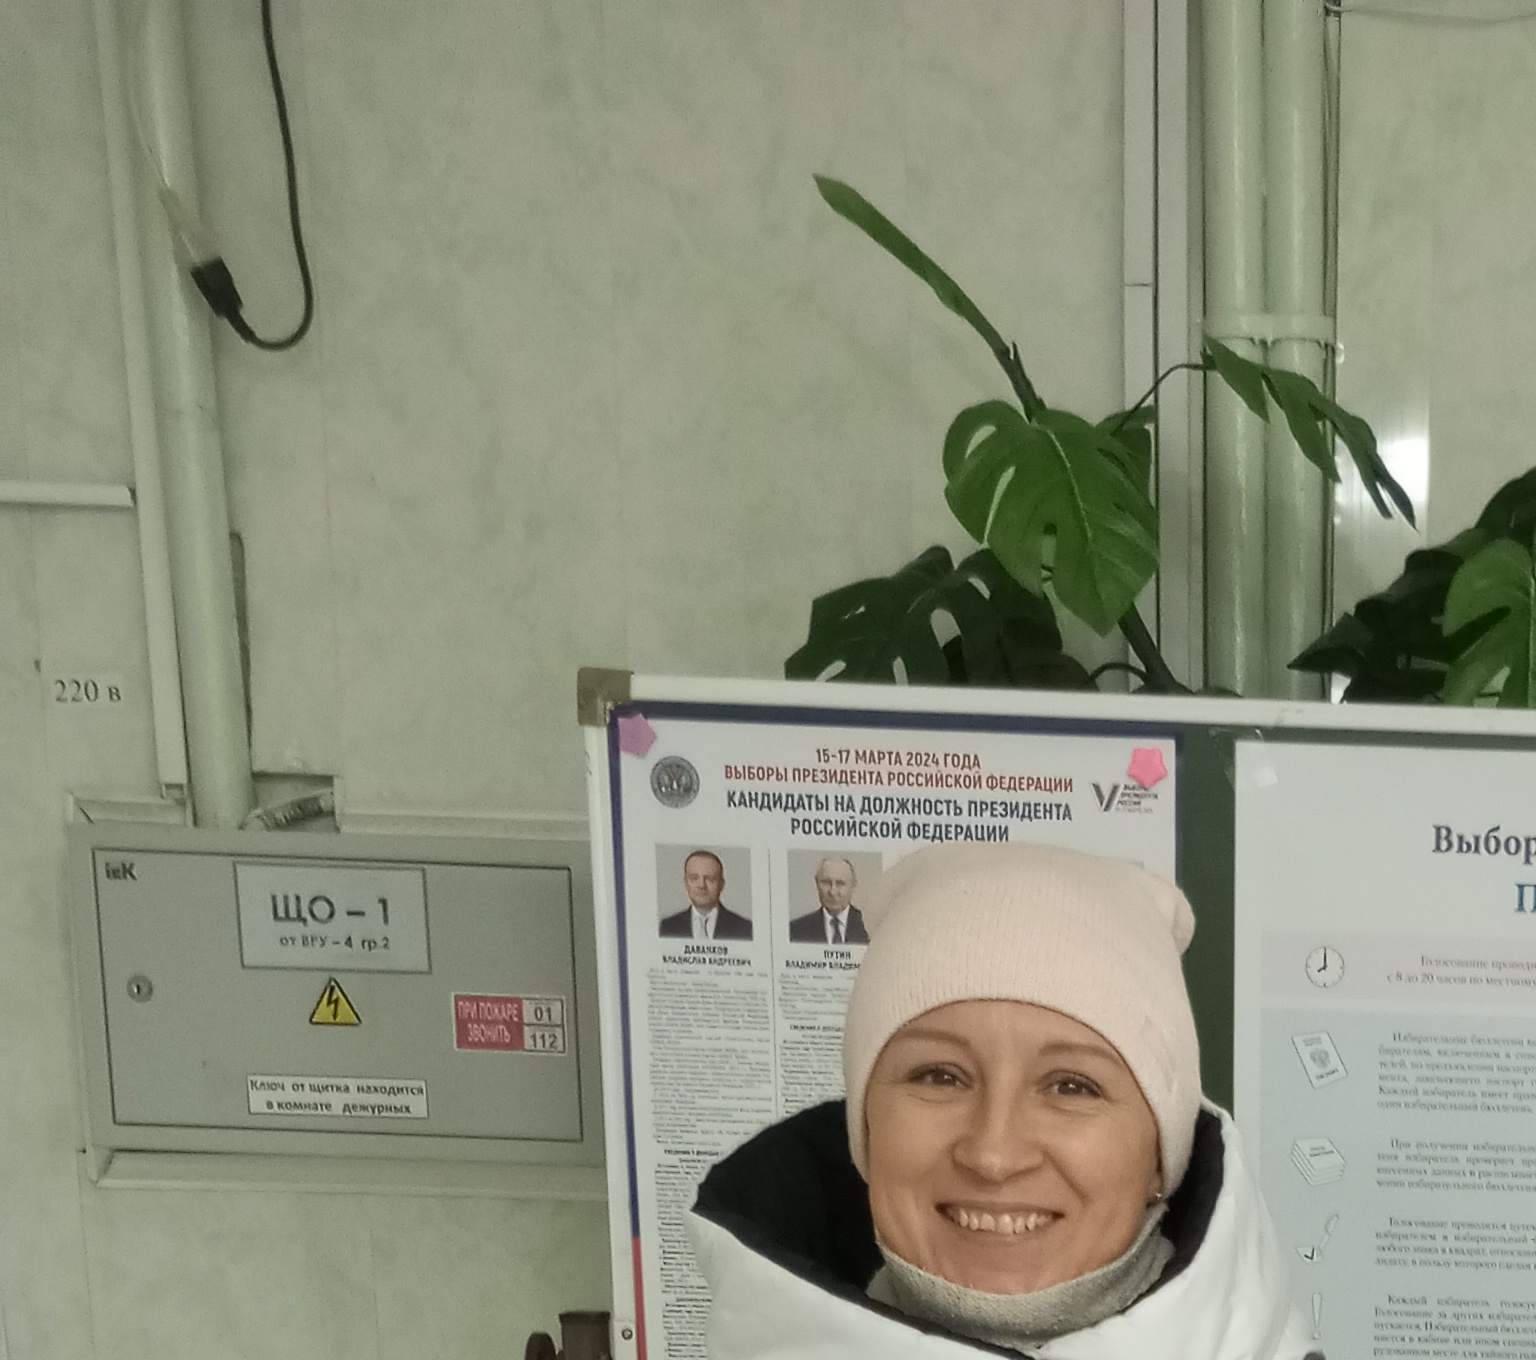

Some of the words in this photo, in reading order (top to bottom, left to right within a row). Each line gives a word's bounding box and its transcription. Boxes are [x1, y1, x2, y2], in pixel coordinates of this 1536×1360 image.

[54, 679, 99, 703] 220
[815, 749, 851, 765] 15-17
[855, 750, 904, 766] МАРТА
[906, 751, 941, 768] 2024
[943, 752, 982, 770] ГОДА
[724, 765, 788, 782] ВЫБОРЫ
[792, 767, 884, 786] ПРЕЗИДЕНТА
[887, 769, 983, 789] РОССИЙСКОЙ
[985, 775, 1073, 793] ФЕДЕРАЦИИ
[727, 791, 829, 812] КАНДИДАТЫ
[834, 794, 856, 813] НА
[859, 796, 963, 820] ДОЛЖНОСТЬ
[967, 800, 1073, 821] ПРЕЗИДЕНТА
[790, 816, 902, 838] РОССИЙСКОЙ
[906, 822, 1009, 843] ФЕДЕРАЦИИ
[270, 894, 336, 926] ЩО
[377, 897, 389, 926] 1
[823, 950, 851, 960] ПУТИН
[534, 1005, 553, 1022] 01
[530, 1032, 558, 1050] 112
[249, 1079, 286, 1095] Ключ
[291, 1082, 305, 1092] от
[308, 1083, 350, 1094] щитка
[356, 1083, 425, 1098] находится
[266, 1102, 274, 1111] в
[276, 1101, 333, 1112] комнате
[341, 1103, 412, 1116] дежурных
